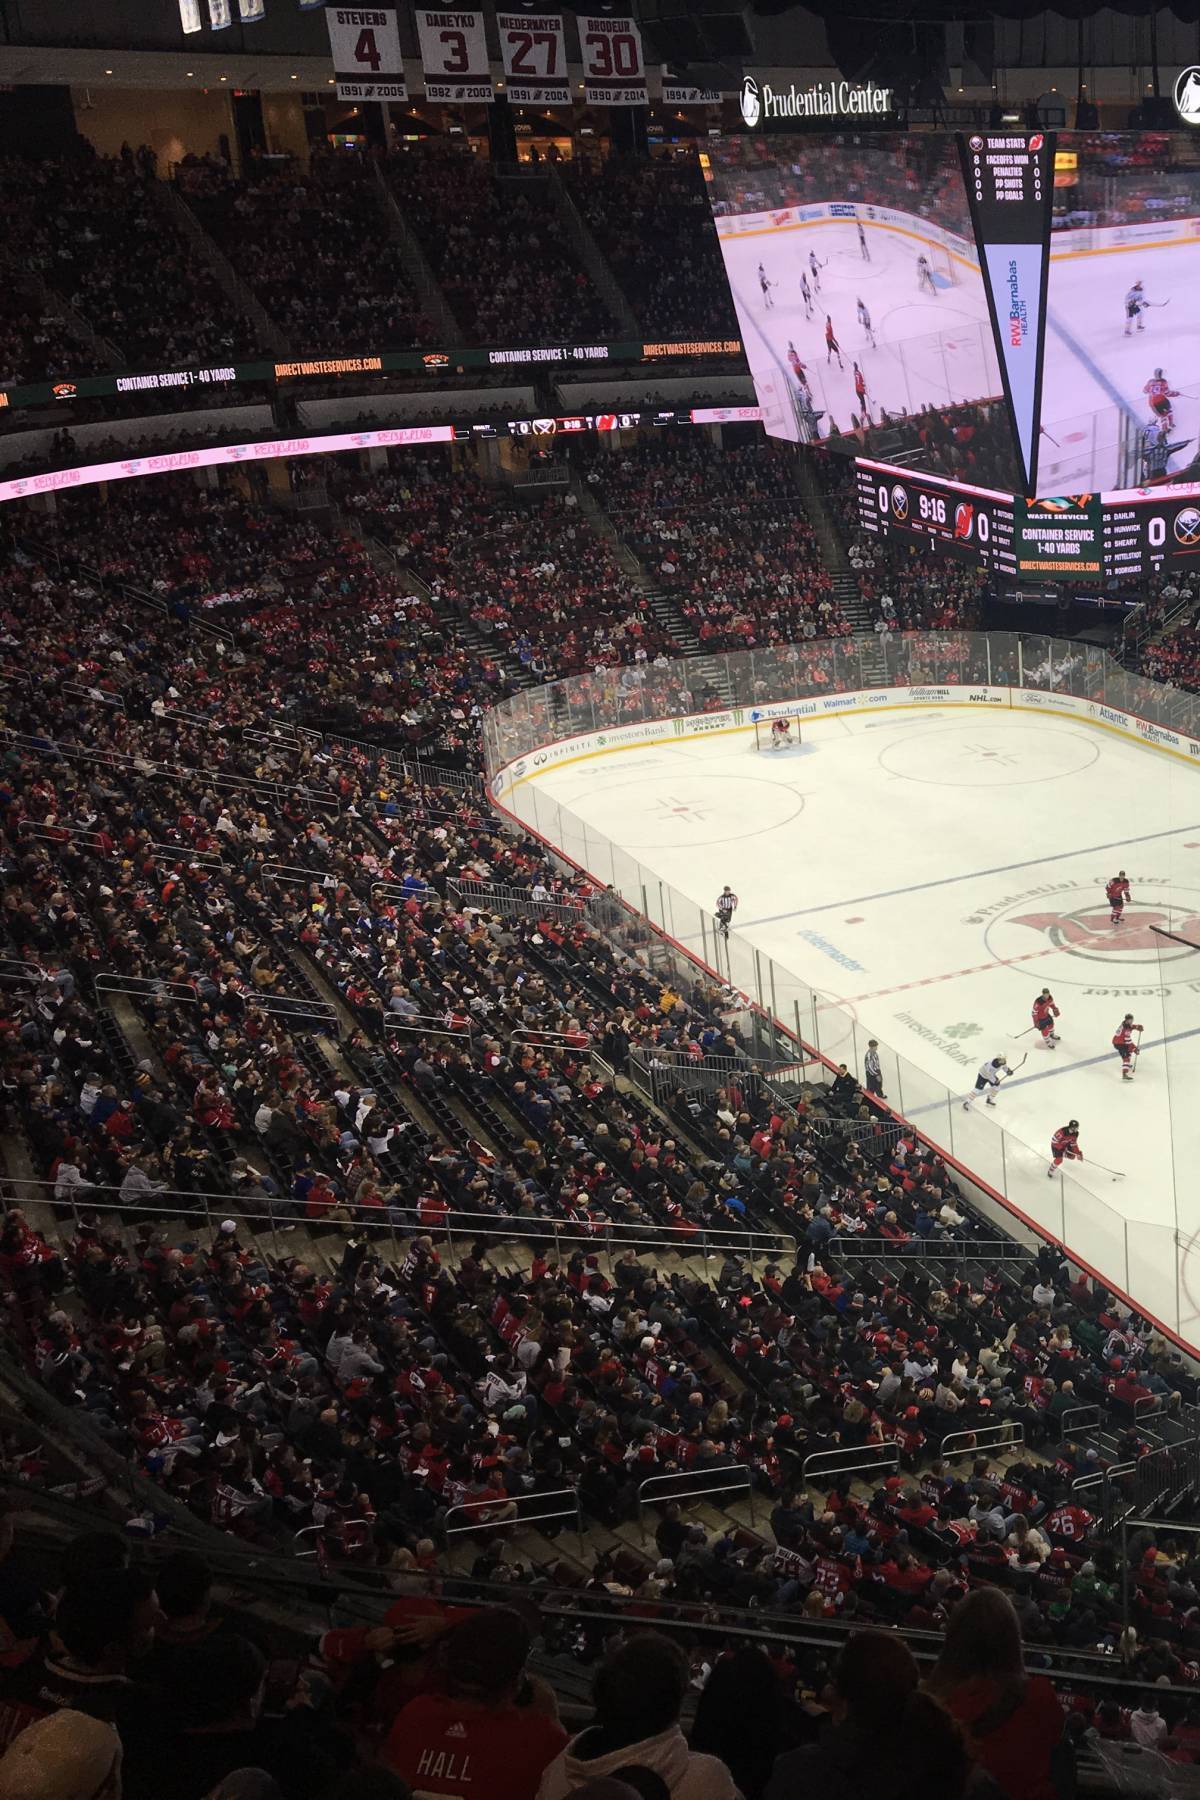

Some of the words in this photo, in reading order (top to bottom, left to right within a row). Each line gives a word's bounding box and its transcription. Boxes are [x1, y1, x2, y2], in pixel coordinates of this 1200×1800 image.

[337, 11, 387, 26] STEVENS
[426, 13, 475, 28] DANEYKO
[500, 19, 561, 31] NIEDERMAYER
[588, 20, 631, 32] BRODEUR
[355, 28, 381, 71] 4
[440, 31, 469, 72] 3
[508, 32, 557, 75] 27
[586, 34, 639, 76] 30
[341, 86, 362, 97] 1991
[378, 86, 404, 97] 2005
[467, 87, 492, 98] 2003
[511, 90, 530, 100] 1991
[545, 90, 568, 100] 2004
[590, 90, 610, 100] 1990
[625, 90, 645, 100] 2014
[666, 90, 686, 100] 1994
[763, 82, 838, 117] Prudential
[840, 81, 890, 114] Center
[987, 138, 1005, 149] TEAM
[1006, 138, 1026, 149] STATS
[973, 155, 980, 165] 8
[1033, 154, 1039, 165] 1
[975, 167, 981, 177] 0
[1034, 167, 1040, 177] 0
[976, 180, 982, 189] 0
[1035, 180, 1041, 189] 0
[977, 191, 983, 201] 0
[1036, 191, 1042, 201] 0
[1007, 260, 1021, 347] RWJBarnabas
[1019, 300, 1028, 336] HEALTH
[489, 350, 531, 364] CONTAINER
[532, 349, 562, 361] SERVICE
[573, 348, 583, 359] 40
[584, 346, 608, 359] YARDS
[643, 341, 740, 356] DIRECTWASTESERVICES.COM
[275, 358, 382, 377] DIRECTWASTESERVICES.COM
[116, 375, 160, 392] CONTAINER
[160, 372, 189, 387] SERVICE
[189, 371, 194, 383] 1
[199, 370, 209, 382] 40
[210, 368, 236, 382] YARDS
[879, 486, 889, 513] 0
[919, 494, 946, 524] 9:16
[1102, 514, 1111, 522] 26
[1114, 511, 1136, 521] DAHLIN
[978, 512, 989, 542] 0
[1022, 528, 1063, 541] CONTAINER
[1064, 529, 1095, 541] SERVICE
[1148, 516, 1166, 547] 0
[930, 538, 936, 551] 1
[1056, 542, 1081, 554] YARDS
[1114, 538, 1137, 548] SHEARY
[1020, 560, 1100, 571] DIRECTWASTESERVICES.COM
[823, 697, 857, 709] Walmart
[969, 694, 1002, 703] NHL.COM
[767, 702, 817, 717] Prudential
[1099, 706, 1129, 728] Atlantic
[1135, 719, 1180, 745] RWJBarnabas
[976, 879, 1078, 916] Prudential
[1050, 1515, 1076, 1536] 76
[416, 1748, 473, 1782] HALL
